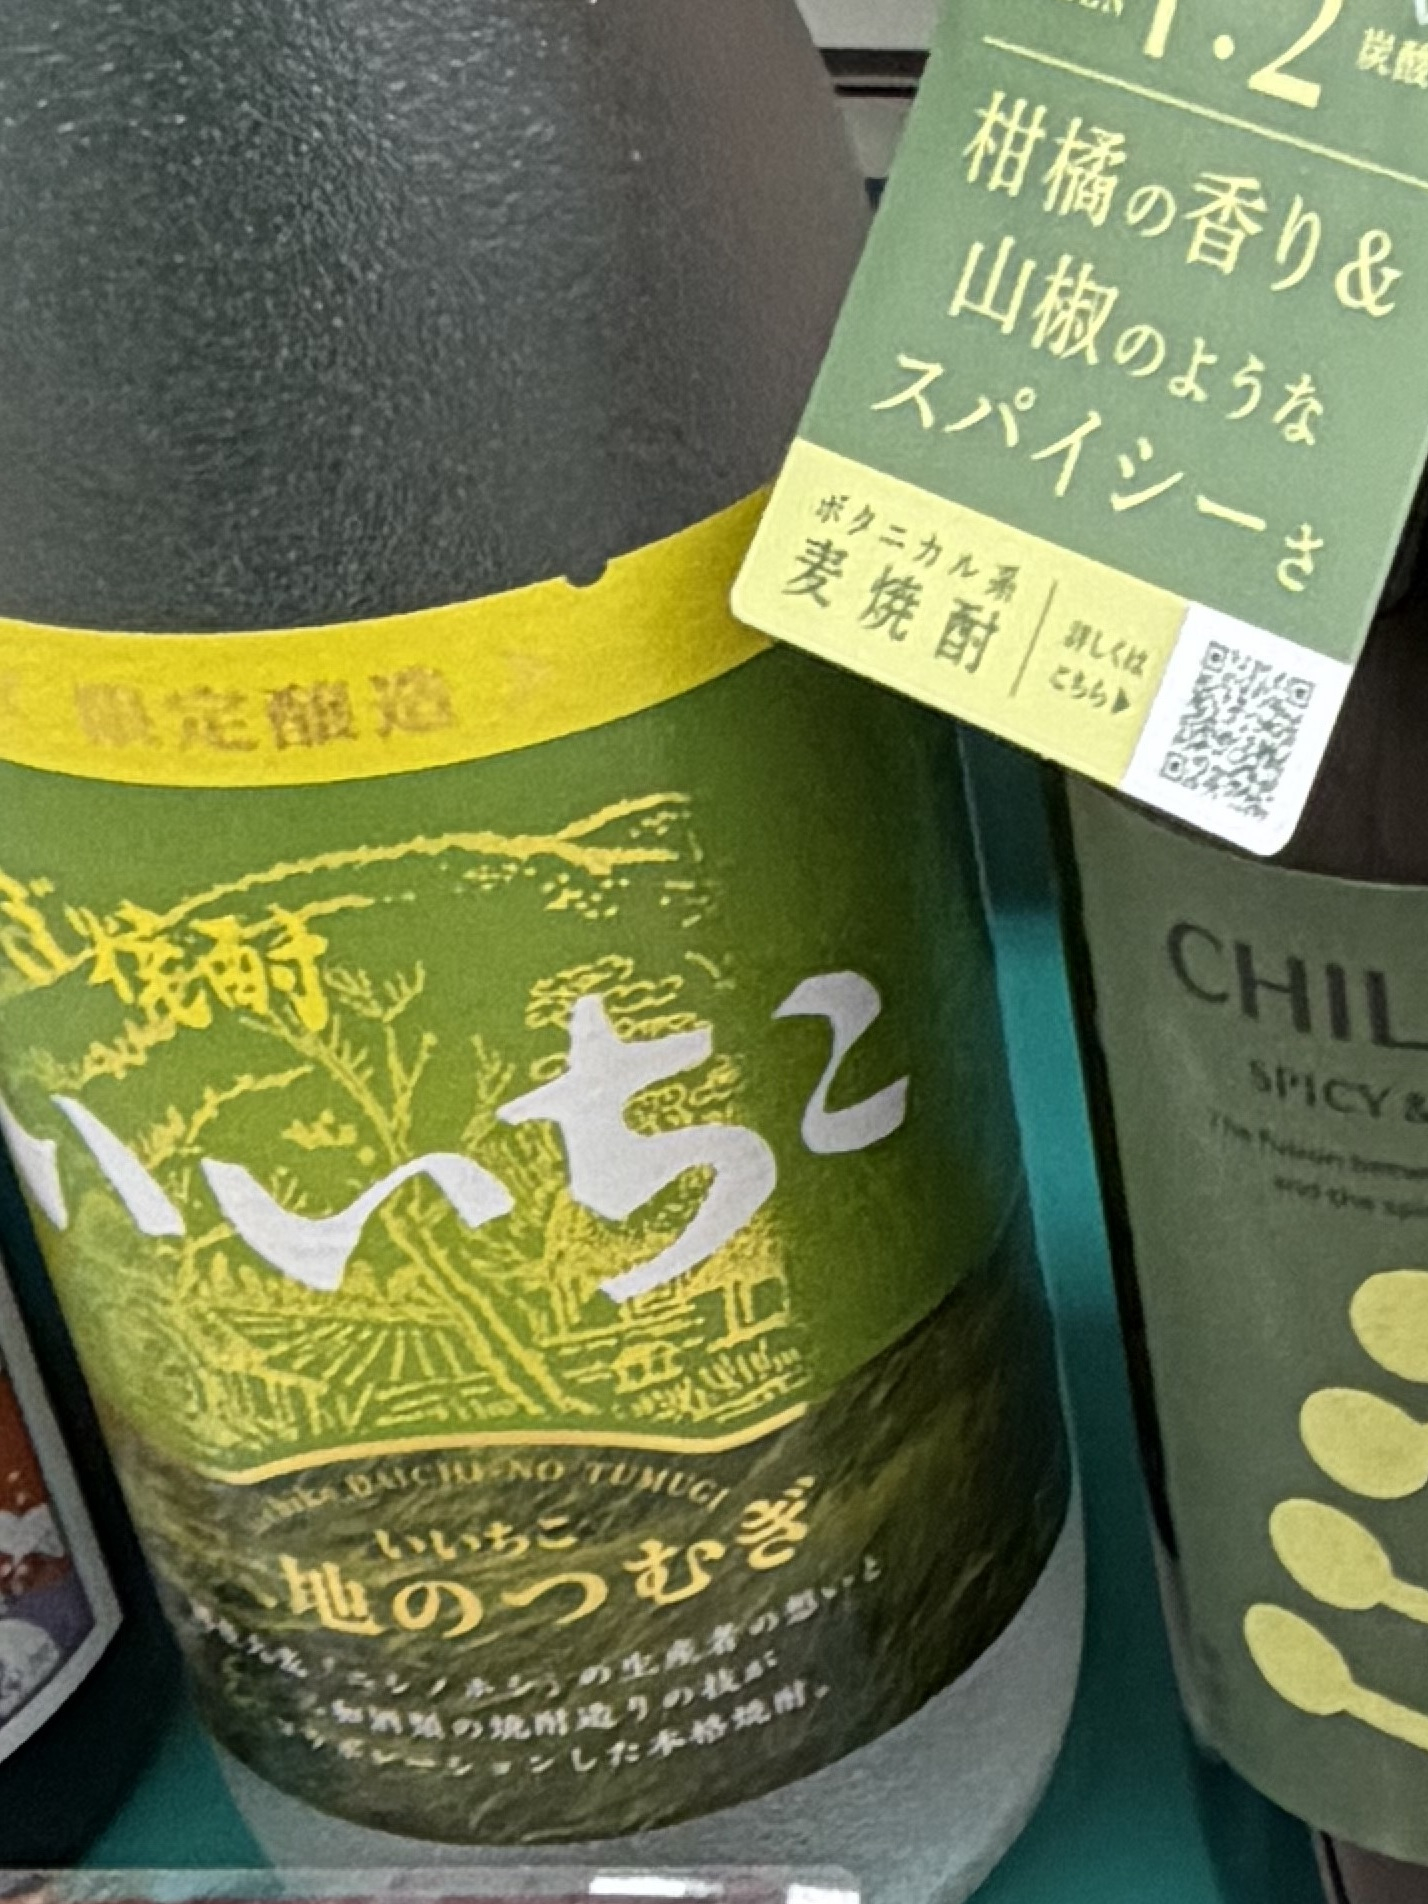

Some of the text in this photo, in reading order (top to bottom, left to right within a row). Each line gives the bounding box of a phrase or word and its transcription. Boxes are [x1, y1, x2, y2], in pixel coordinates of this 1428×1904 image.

[962, 90, 1405, 319] 柑橘の香り&
[947, 234, 1326, 448] 山椒のような
[870, 352, 1326, 593] スパイシーさ
[781, 534, 1001, 676] 麦焼酎
[813, 492, 1023, 607] ボタニカル系
[1048, 662, 1111, 713] こちら
[1062, 617, 1150, 678] 詳しくは
[1249, 1058, 1391, 1119] SPICY
[374, 1518, 580, 1562] いいちこ
